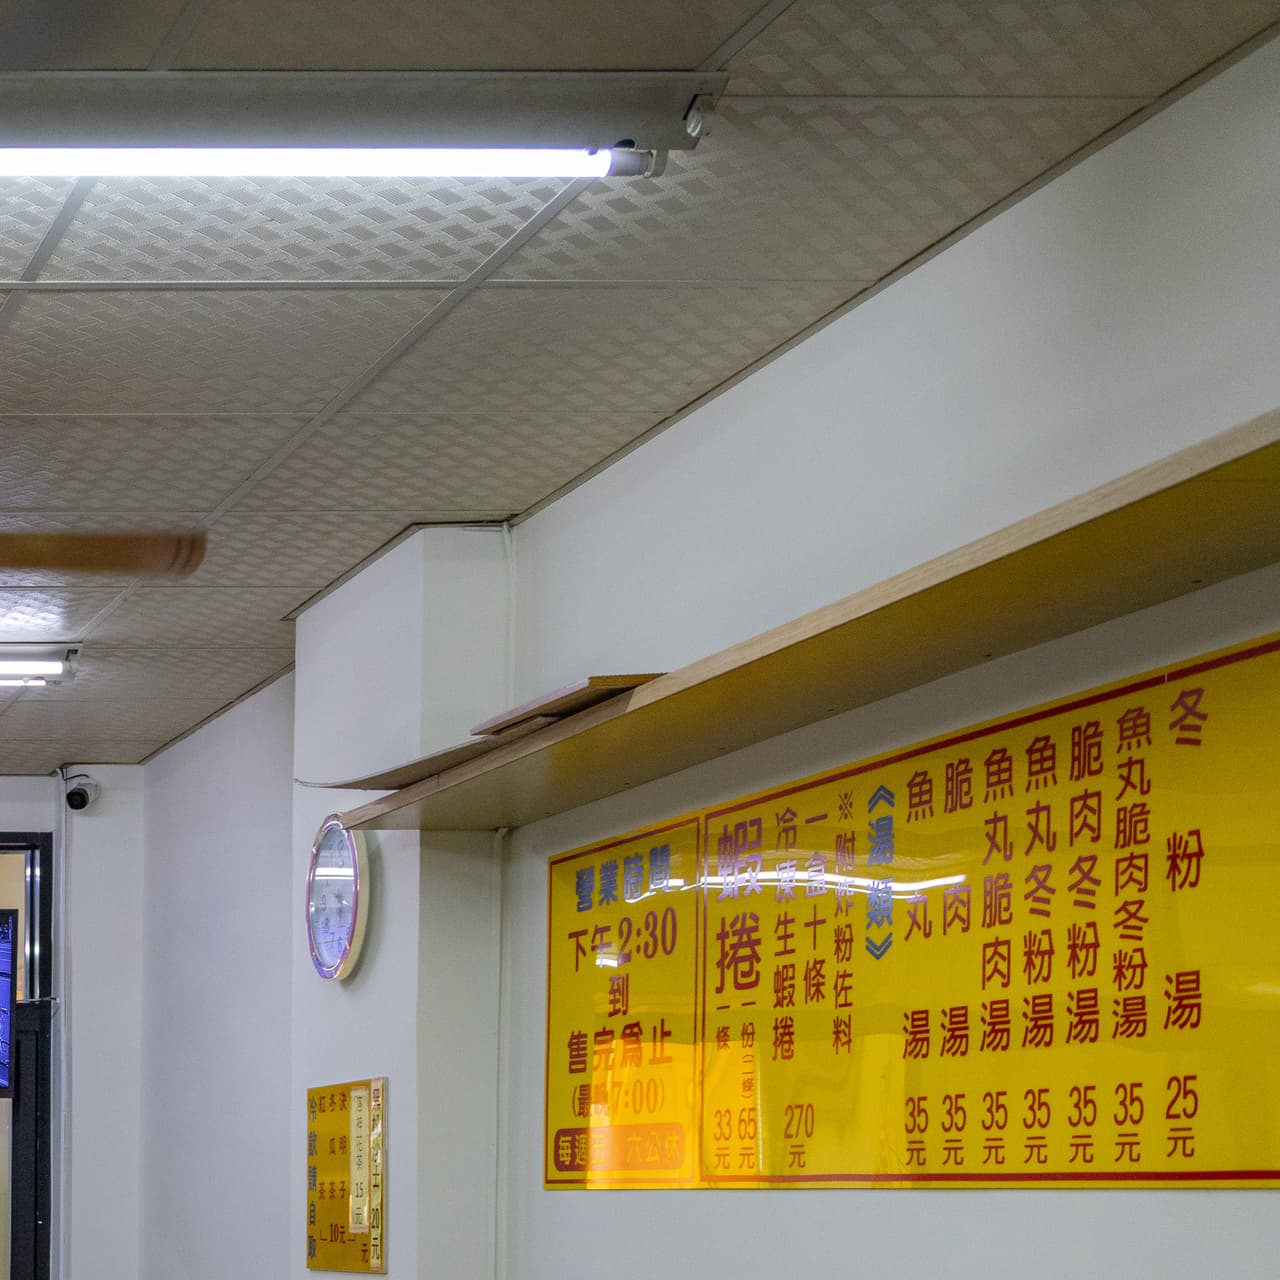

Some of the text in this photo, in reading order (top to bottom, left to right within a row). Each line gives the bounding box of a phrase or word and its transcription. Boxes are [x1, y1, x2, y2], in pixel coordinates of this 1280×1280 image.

[575, 844, 672, 912] 營業時間
[608, 973, 630, 1018] 到
[716, 817, 762, 995] 蝦捲
[803, 813, 828, 1006] 一盒十條
[902, 769, 934, 1060] 魚丸湯
[939, 758, 973, 1058] 脆肉湯
[979, 747, 1014, 1053] 魚丸脆肉湯
[1022, 735, 1058, 1049] 魚丸冬粉湯
[1066, 720, 1105, 1044] 脆肉冬粉湯
[1111, 706, 1153, 1040] 魚丸脆肉冬粉湯
[1163, 687, 1208, 1031] 冬粉湯
[716, 1005, 730, 1052] 一條
